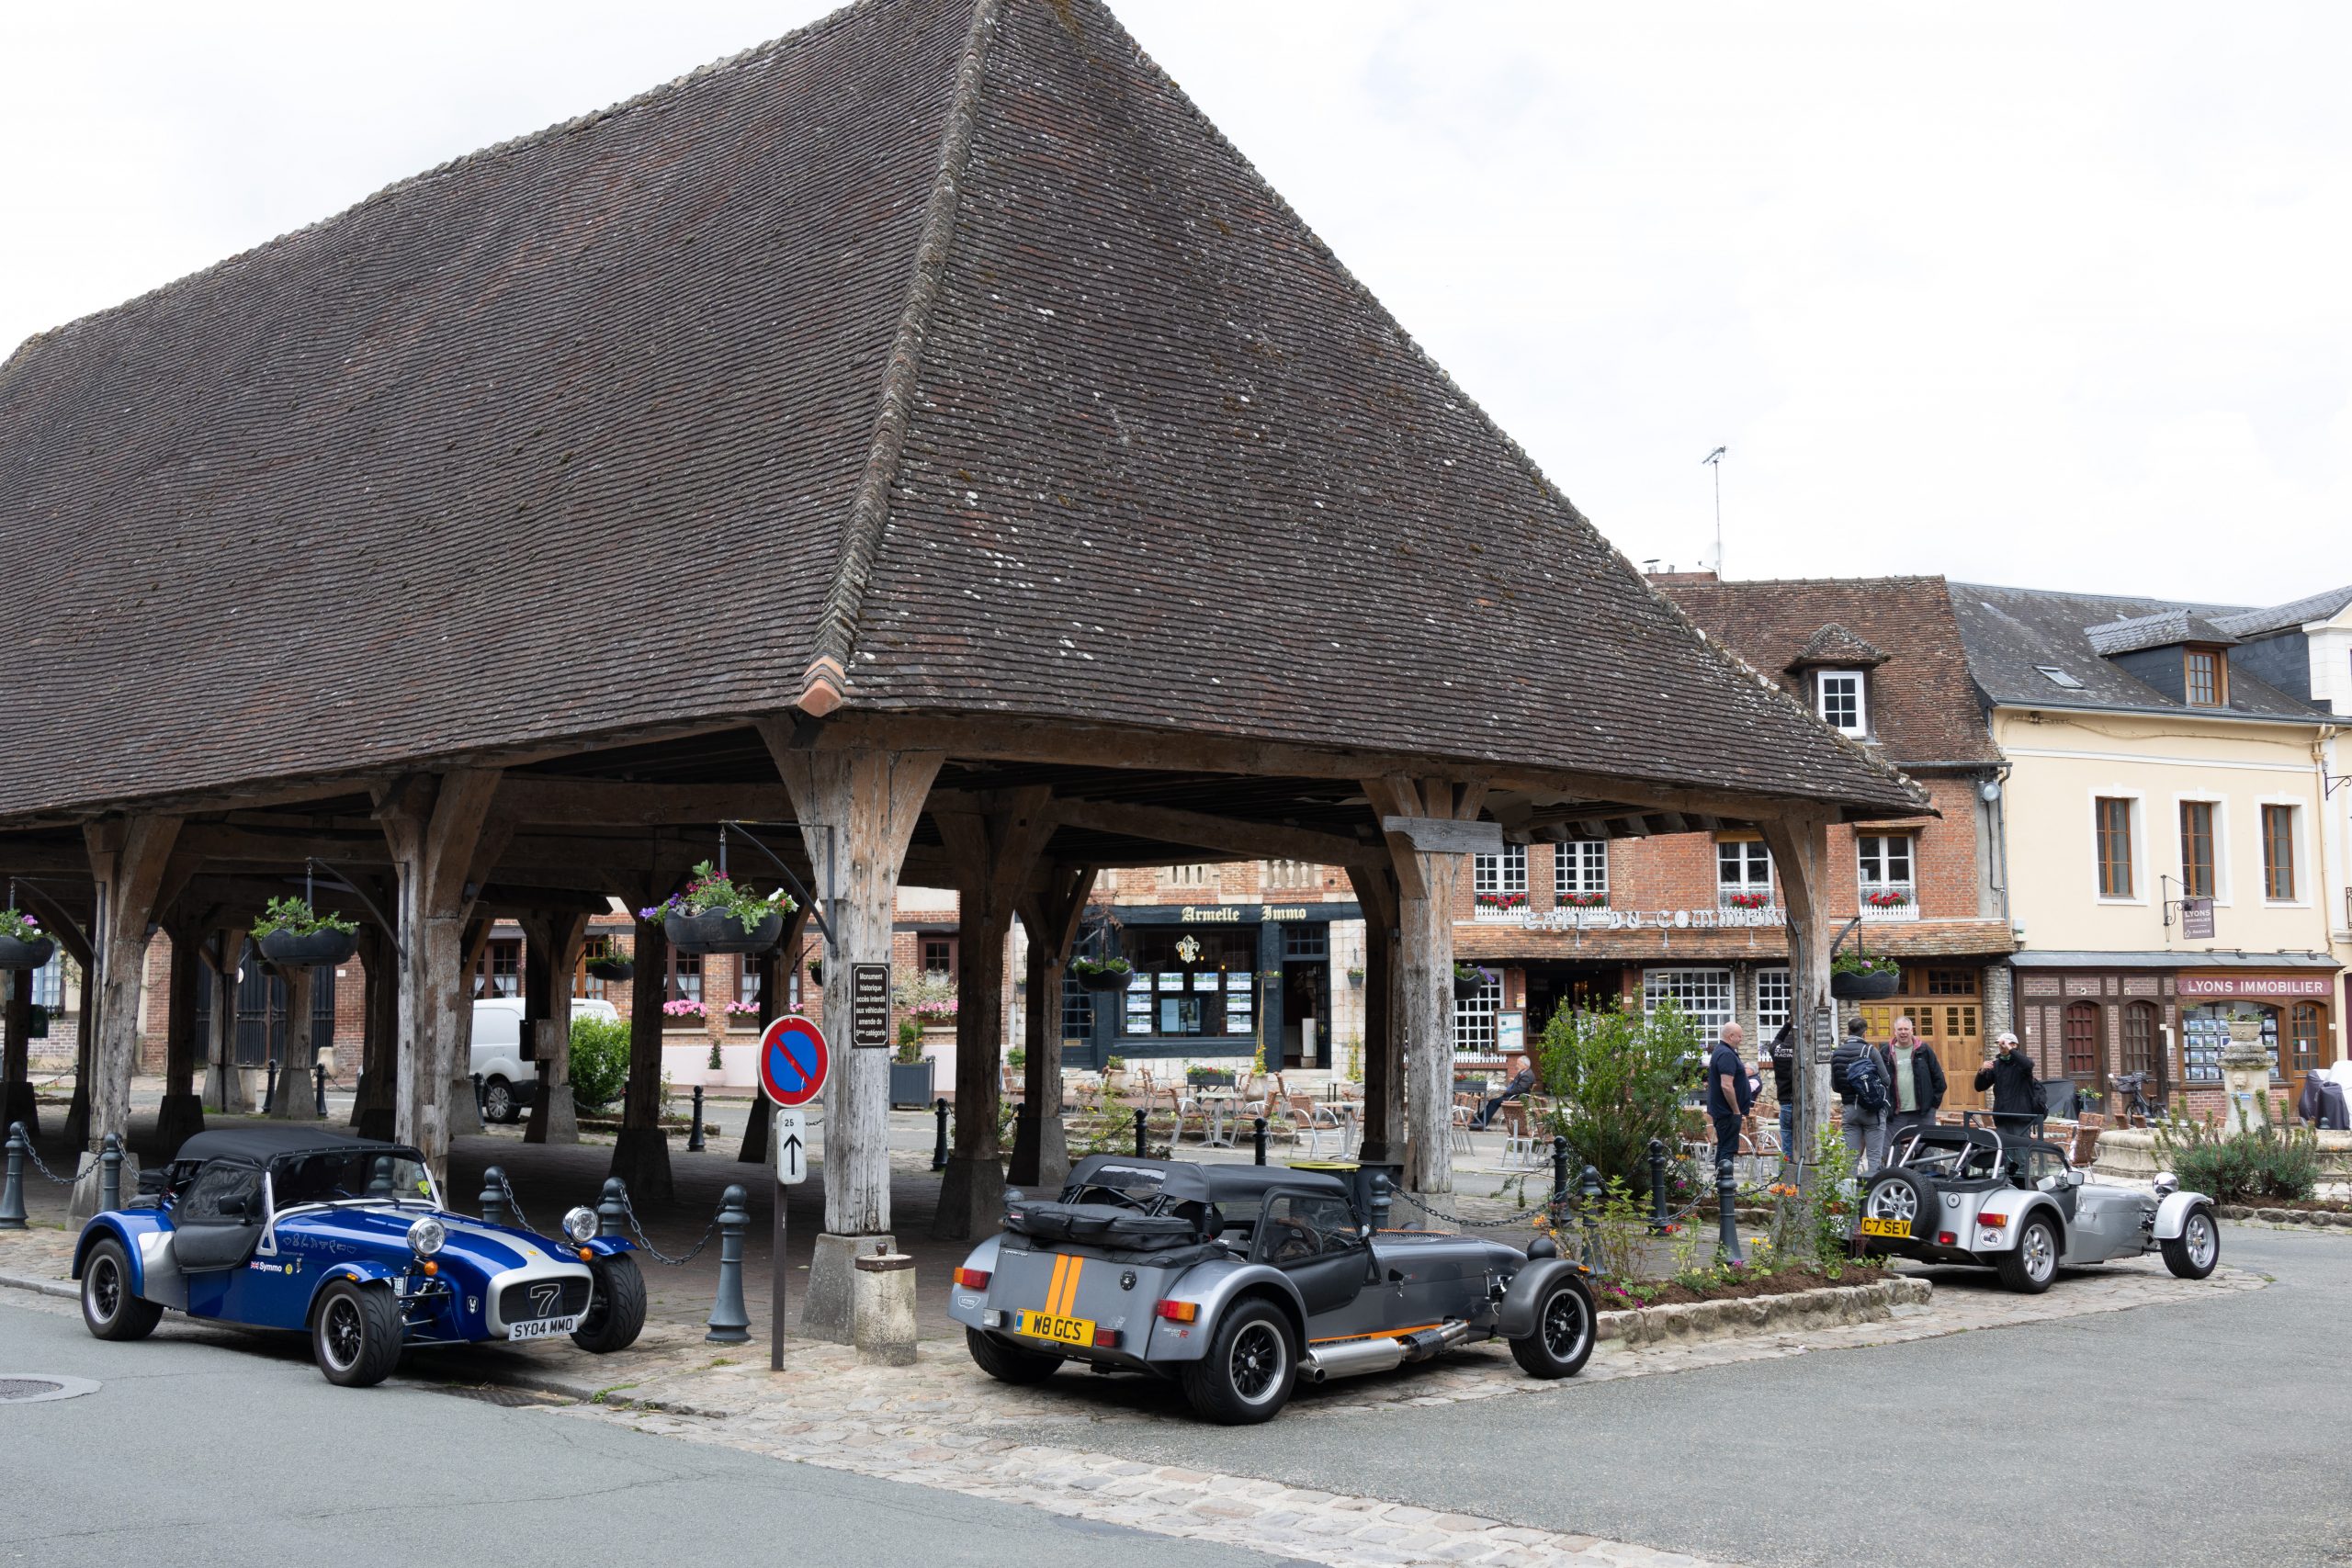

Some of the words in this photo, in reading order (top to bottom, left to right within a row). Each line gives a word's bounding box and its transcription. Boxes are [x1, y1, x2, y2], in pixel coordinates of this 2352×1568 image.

[1182, 907, 1240, 922] Armelle
[1261, 905, 1306, 921] Immo
[859, 985, 882, 993] historique
[2188, 981, 2233, 992] LYONS
[2240, 981, 2324, 993] IMMOBILIER
[865, 1029, 886, 1038] catégorie
[785, 1118, 795, 1127] 25
[1863, 1220, 1881, 1233] C7
[1883, 1222, 1909, 1235] SEV
[259, 1261, 282, 1272] Symmo
[529, 1283, 560, 1317] 7
[514, 1322, 547, 1337] SY04
[549, 1318, 573, 1334] MMO
[1033, 1314, 1051, 1335] W8
[1054, 1318, 1082, 1340] GCS
